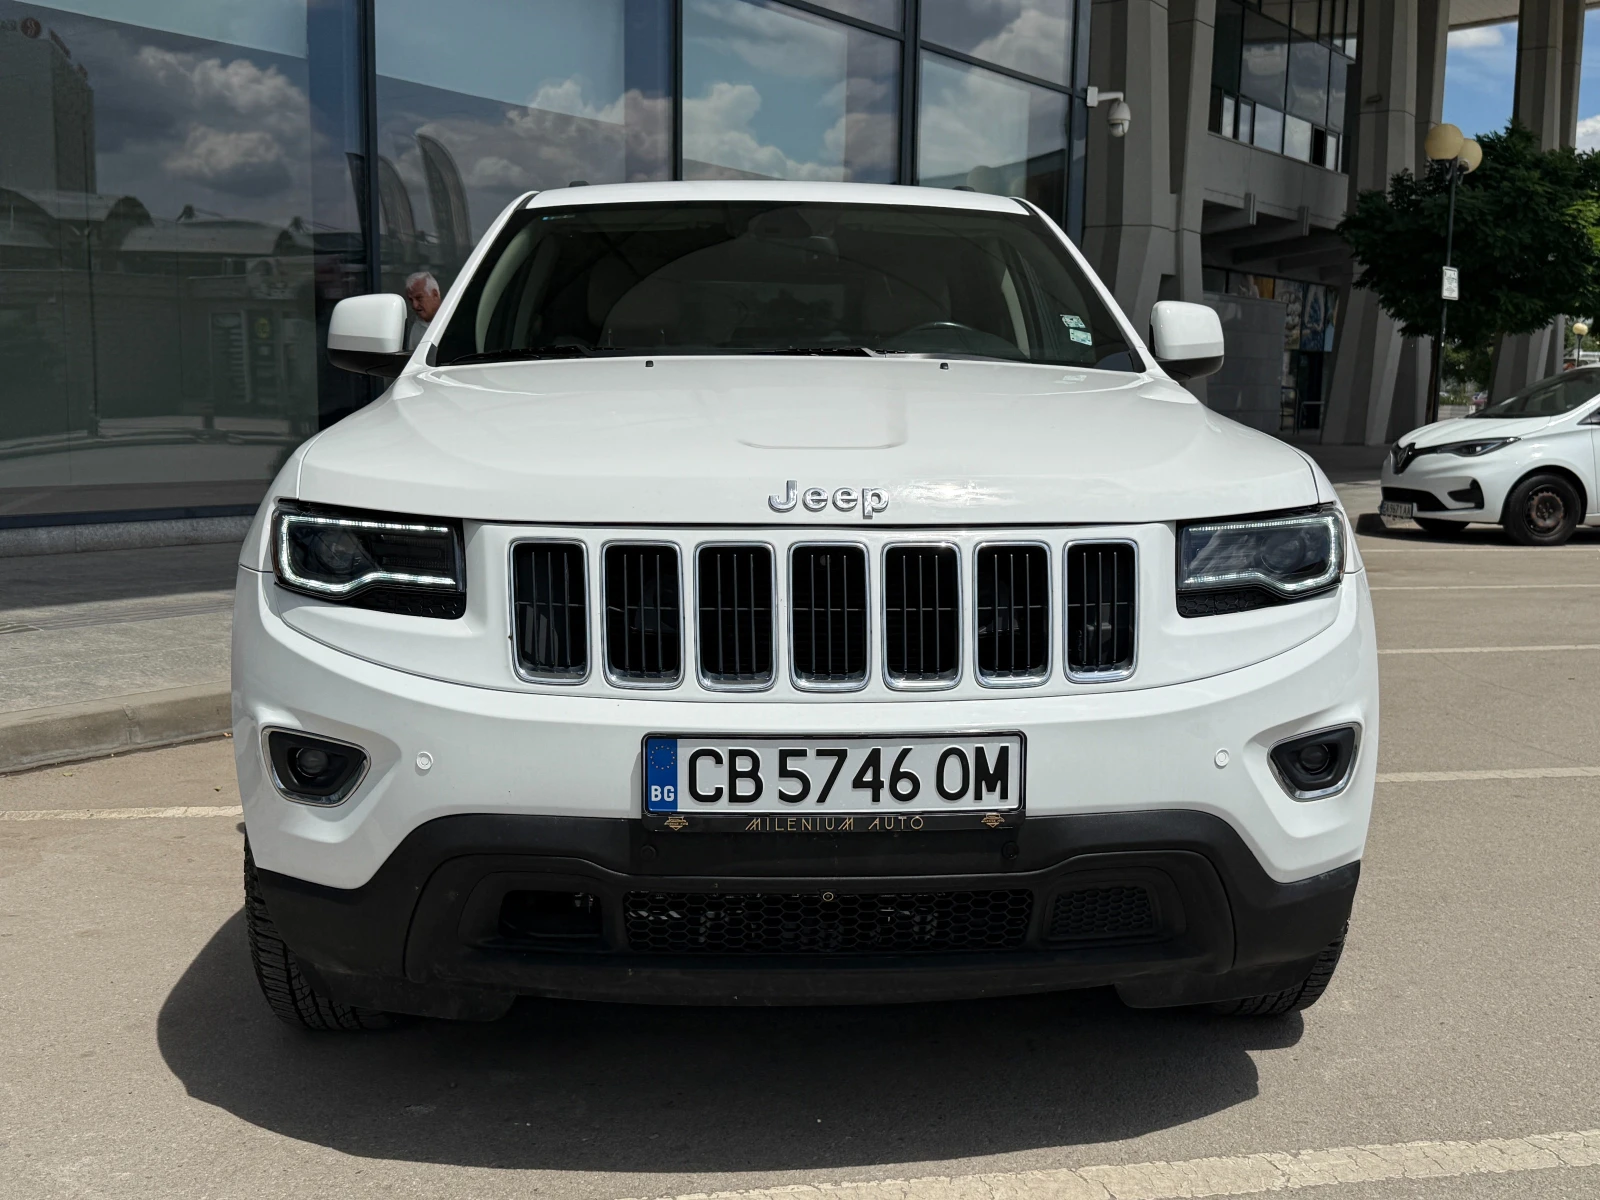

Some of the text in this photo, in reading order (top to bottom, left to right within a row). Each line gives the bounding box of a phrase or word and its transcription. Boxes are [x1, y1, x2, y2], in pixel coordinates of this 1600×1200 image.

[768, 480, 889, 520] Jeep
[688, 745, 1009, 804] CB 5746 OM
[651, 785, 675, 801] BG
[745, 815, 924, 831] MILENIUM AUTO
